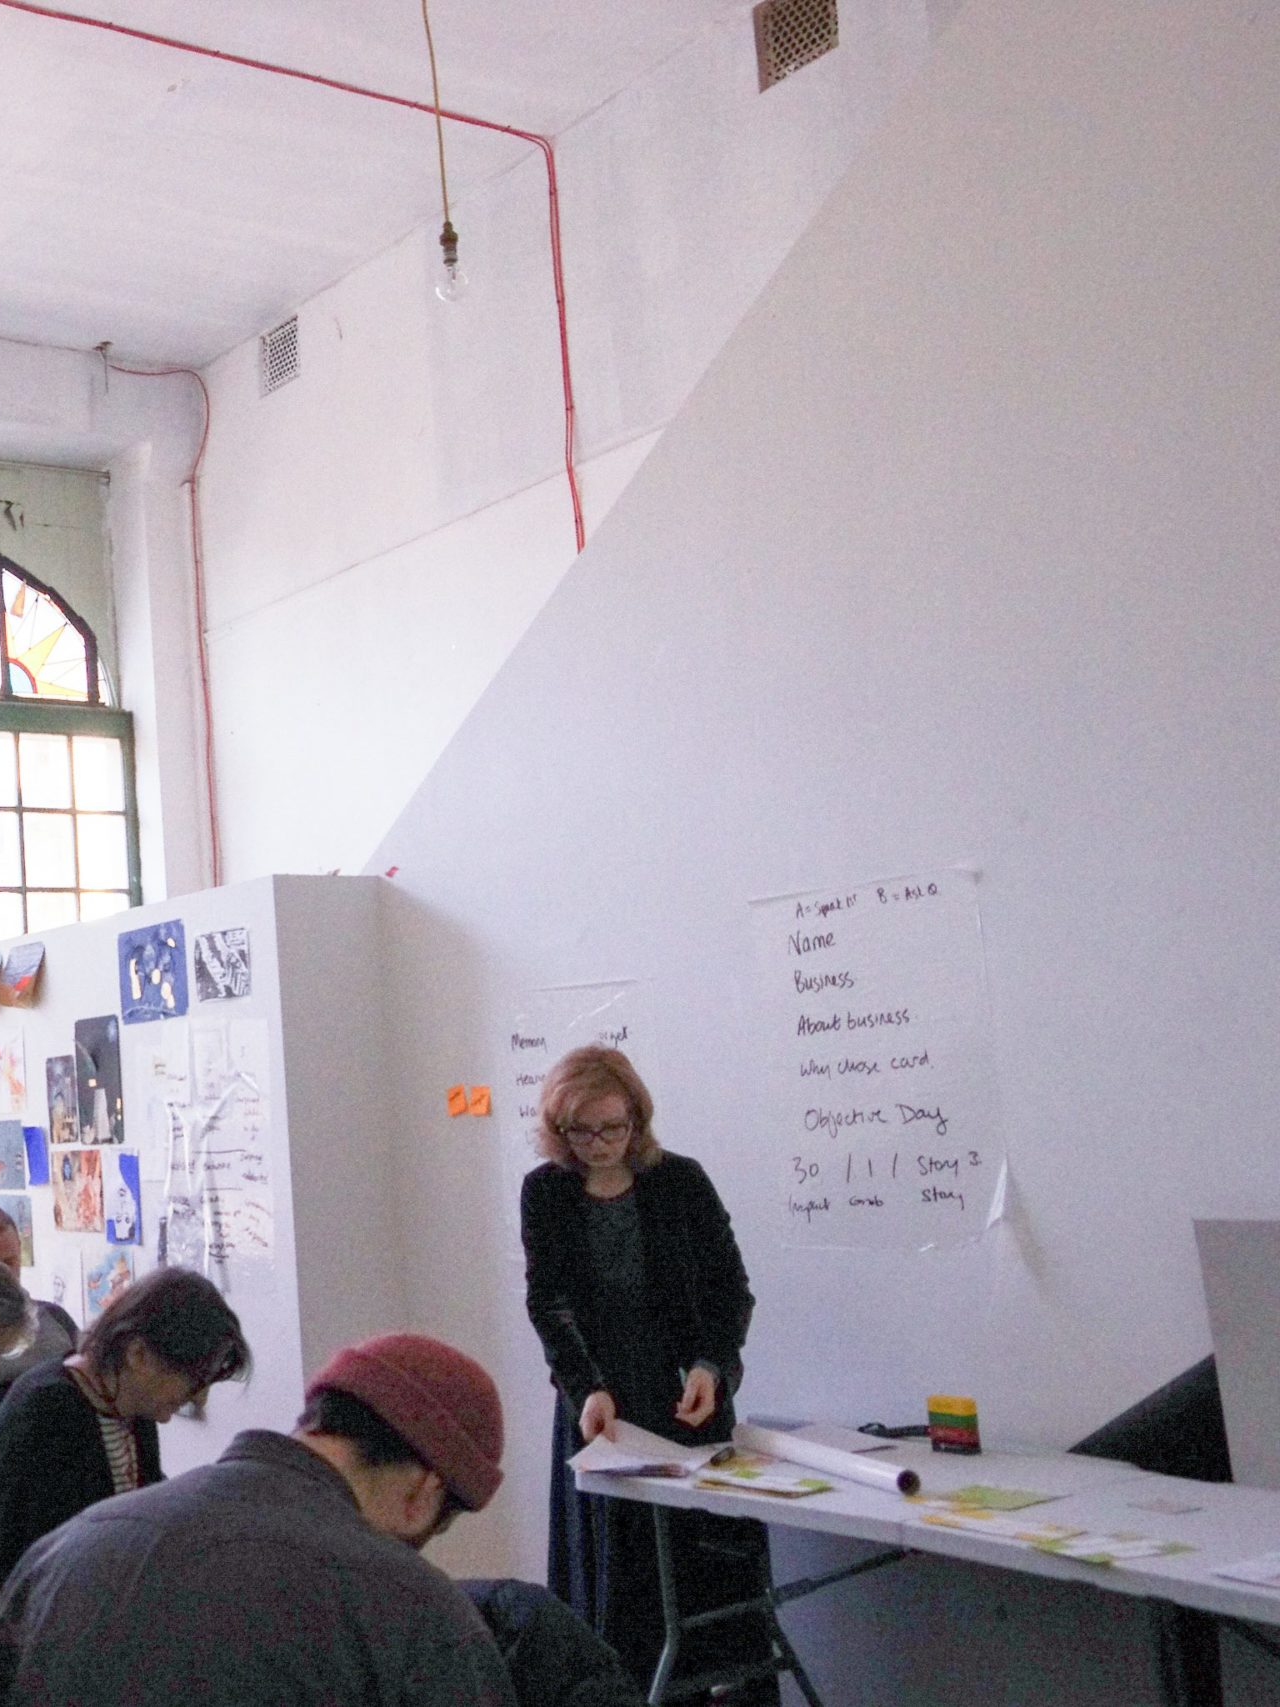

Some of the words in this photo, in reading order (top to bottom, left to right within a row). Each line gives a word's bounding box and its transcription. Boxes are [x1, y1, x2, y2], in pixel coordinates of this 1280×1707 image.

[788, 930, 837, 956] Name
[794, 969, 855, 994] Business
[797, 1013, 841, 1036] About
[847, 1008, 910, 1030] business
[804, 1107, 888, 1139] Objective
[895, 1103, 949, 1136] Day
[793, 1156, 819, 1184] 30
